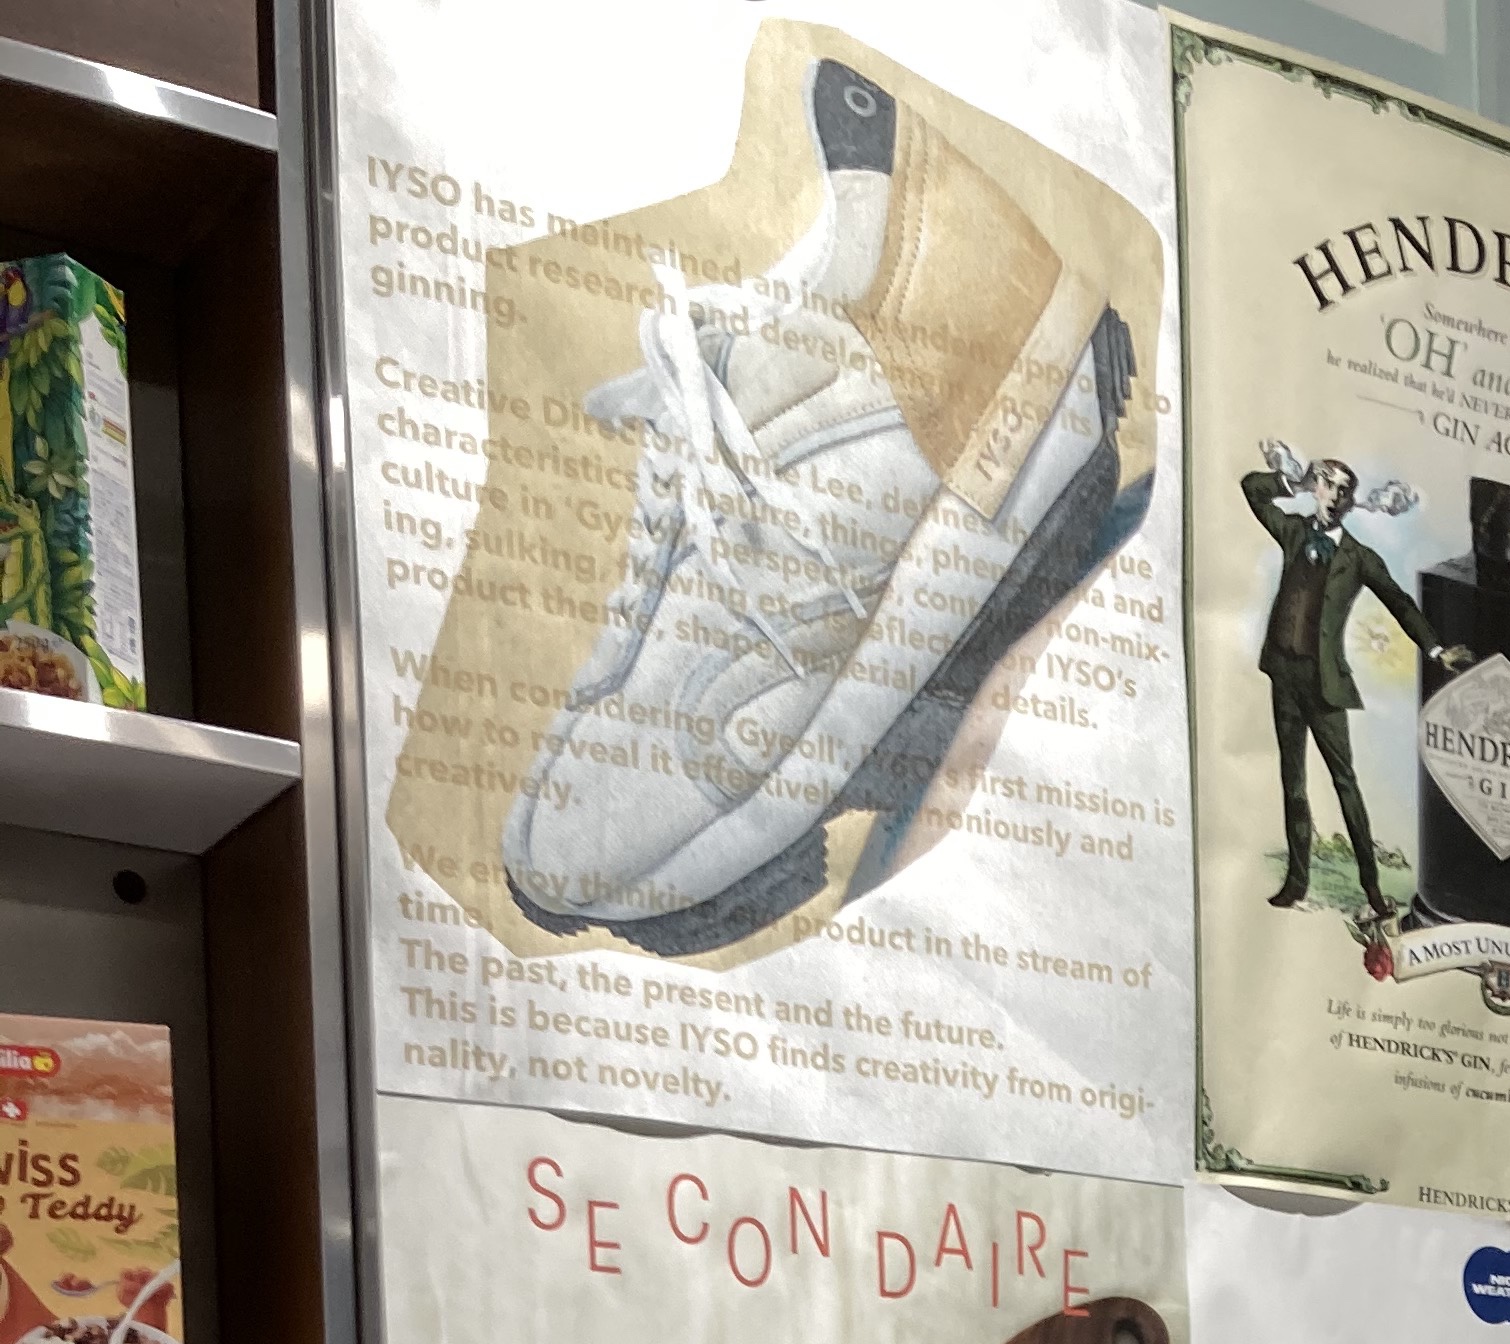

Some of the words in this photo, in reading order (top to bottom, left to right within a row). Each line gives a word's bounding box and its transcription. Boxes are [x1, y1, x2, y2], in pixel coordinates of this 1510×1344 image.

[367, 154, 461, 207] IYSO
[474, 180, 535, 230] has
[548, 211, 742, 288] maintained
[753, 275, 791, 304] an
[368, 213, 519, 274] product
[529, 255, 679, 316] research
[688, 300, 750, 336] and
[371, 261, 527, 331] ginning.
[1423, 301, 1508, 347] Somewhere
[1326, 347, 1342, 368] he
[1346, 357, 1400, 385] realized
[1402, 370, 1429, 392] that
[375, 353, 531, 420] Creative
[543, 394, 696, 463] Director,
[811, 464, 872, 511] Lee,
[1432, 411, 1480, 447] GIN
[377, 407, 639, 492] characteristics
[1114, 596, 1163, 625] and
[380, 456, 507, 512] culture
[520, 485, 554, 522] in
[387, 556, 531, 608] product
[991, 686, 1098, 731] details.
[1001, 650, 1036, 675] on
[1046, 651, 1139, 699] IYSO's
[389, 645, 498, 699] When
[1035, 780, 1145, 824] mission
[1153, 797, 1176, 828] is
[392, 694, 472, 741] how
[484, 714, 519, 750] to
[532, 731, 640, 770] reveal
[650, 739, 673, 776] it
[1080, 831, 1134, 862] and
[396, 753, 581, 811] creatively.
[402, 845, 458, 879] We
[792, 916, 914, 957] product
[924, 933, 953, 963] in
[960, 932, 1009, 976] the
[1016, 949, 1114, 985] stream
[1122, 961, 1153, 990] of
[1406, 948, 1424, 967] A
[401, 936, 468, 976] The
[480, 952, 568, 992] past,
[577, 960, 633, 996] the
[642, 978, 764, 1019] present
[774, 998, 833, 1028] and
[840, 1002, 892, 1037] the
[902, 1010, 1004, 1052] future.
[1327, 998, 1352, 1020] Life
[1356, 1006, 1367, 1020] is
[1371, 1009, 1414, 1034] simply
[1439, 1019, 1485, 1043] glorious
[1488, 1030, 1509, 1045] not
[400, 985, 476, 1023] This
[489, 994, 517, 1029] is
[528, 1000, 670, 1048] because
[680, 1022, 759, 1061] IYSO
[767, 1037, 845, 1075] finds
[856, 1052, 998, 1100] creativity
[1006, 1066, 1072, 1104] from
[1080, 1081, 1156, 1120] origi-
[403, 1038, 518, 1083] nality,
[528, 1050, 588, 1082] not
[598, 1061, 733, 1107] novelty.
[1329, 1030, 1347, 1048] of
[1394, 1070, 1446, 1094] infusions
[1450, 1079, 1465, 1099] of
[20, 1191, 143, 1235] Teddy
